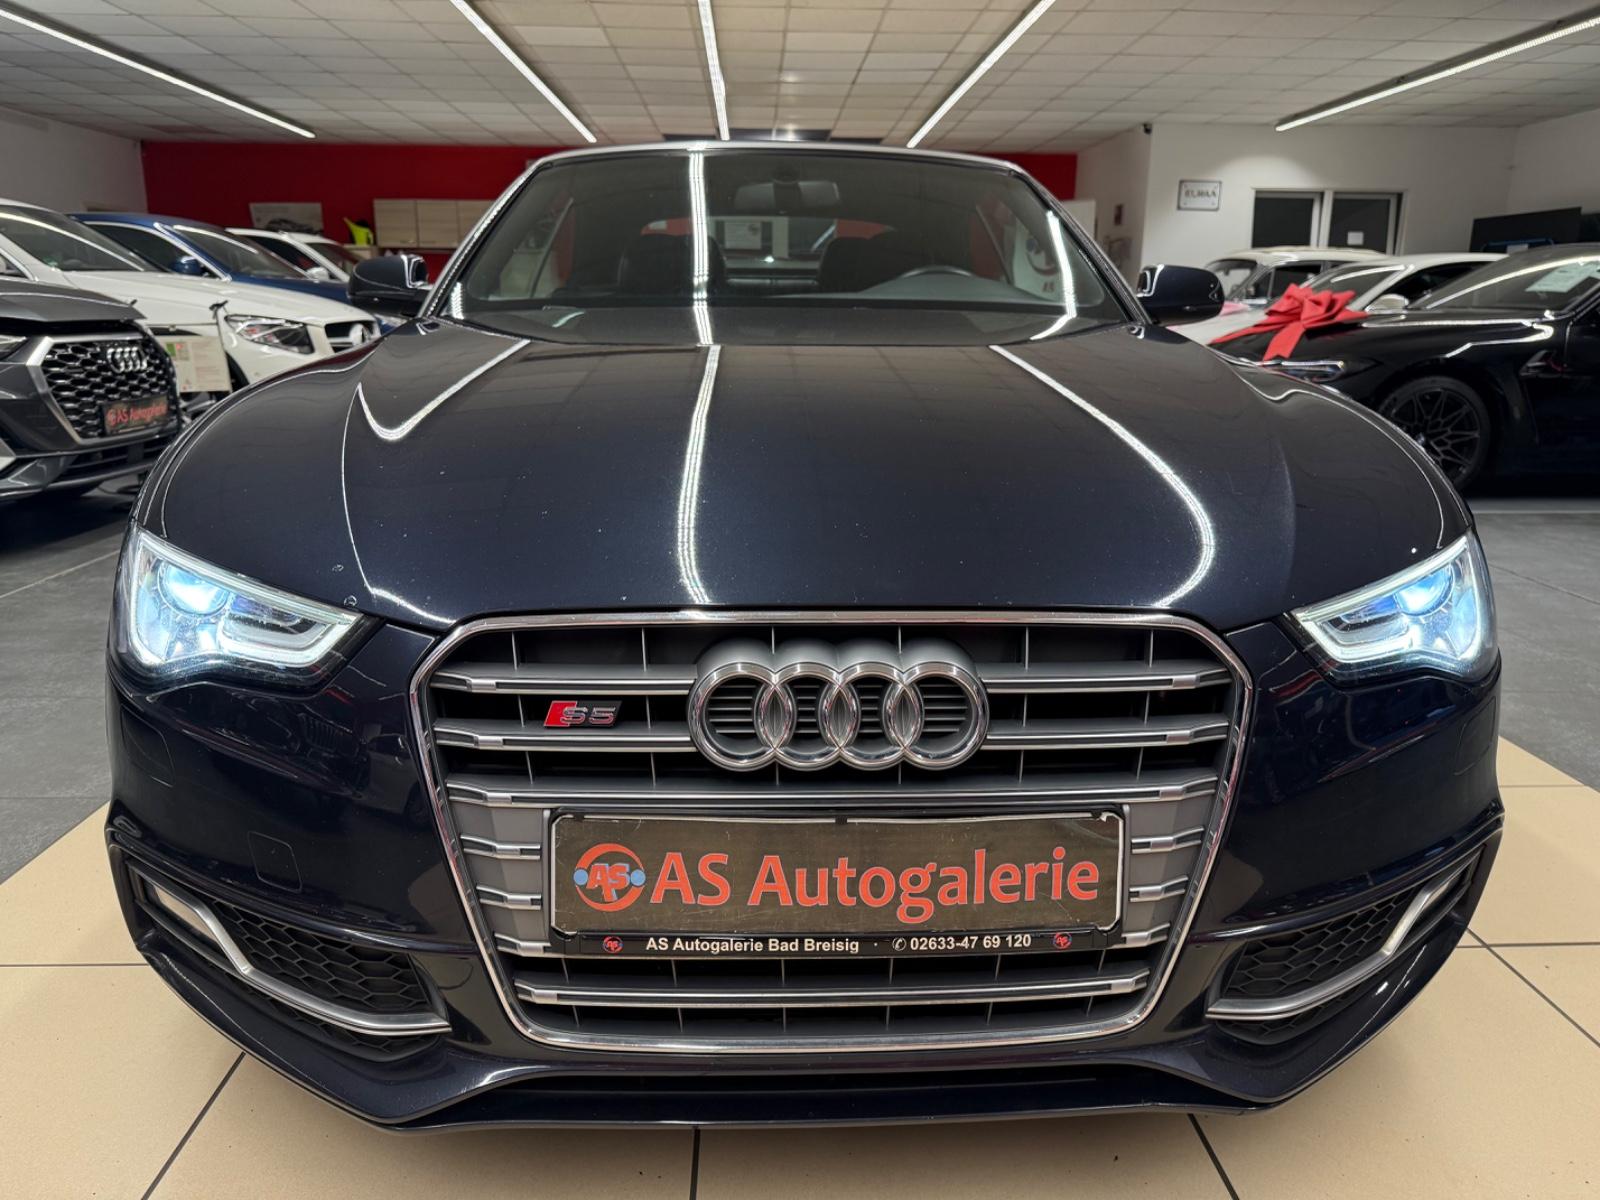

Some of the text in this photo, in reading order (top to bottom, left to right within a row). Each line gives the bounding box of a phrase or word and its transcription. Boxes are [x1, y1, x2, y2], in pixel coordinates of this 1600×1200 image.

[560, 706, 616, 725] S5
[650, 847, 1099, 924] AS Autogalerie
[646, 934, 1032, 955] AS Autogalerie Bad Breisig 02633-47 69 120
